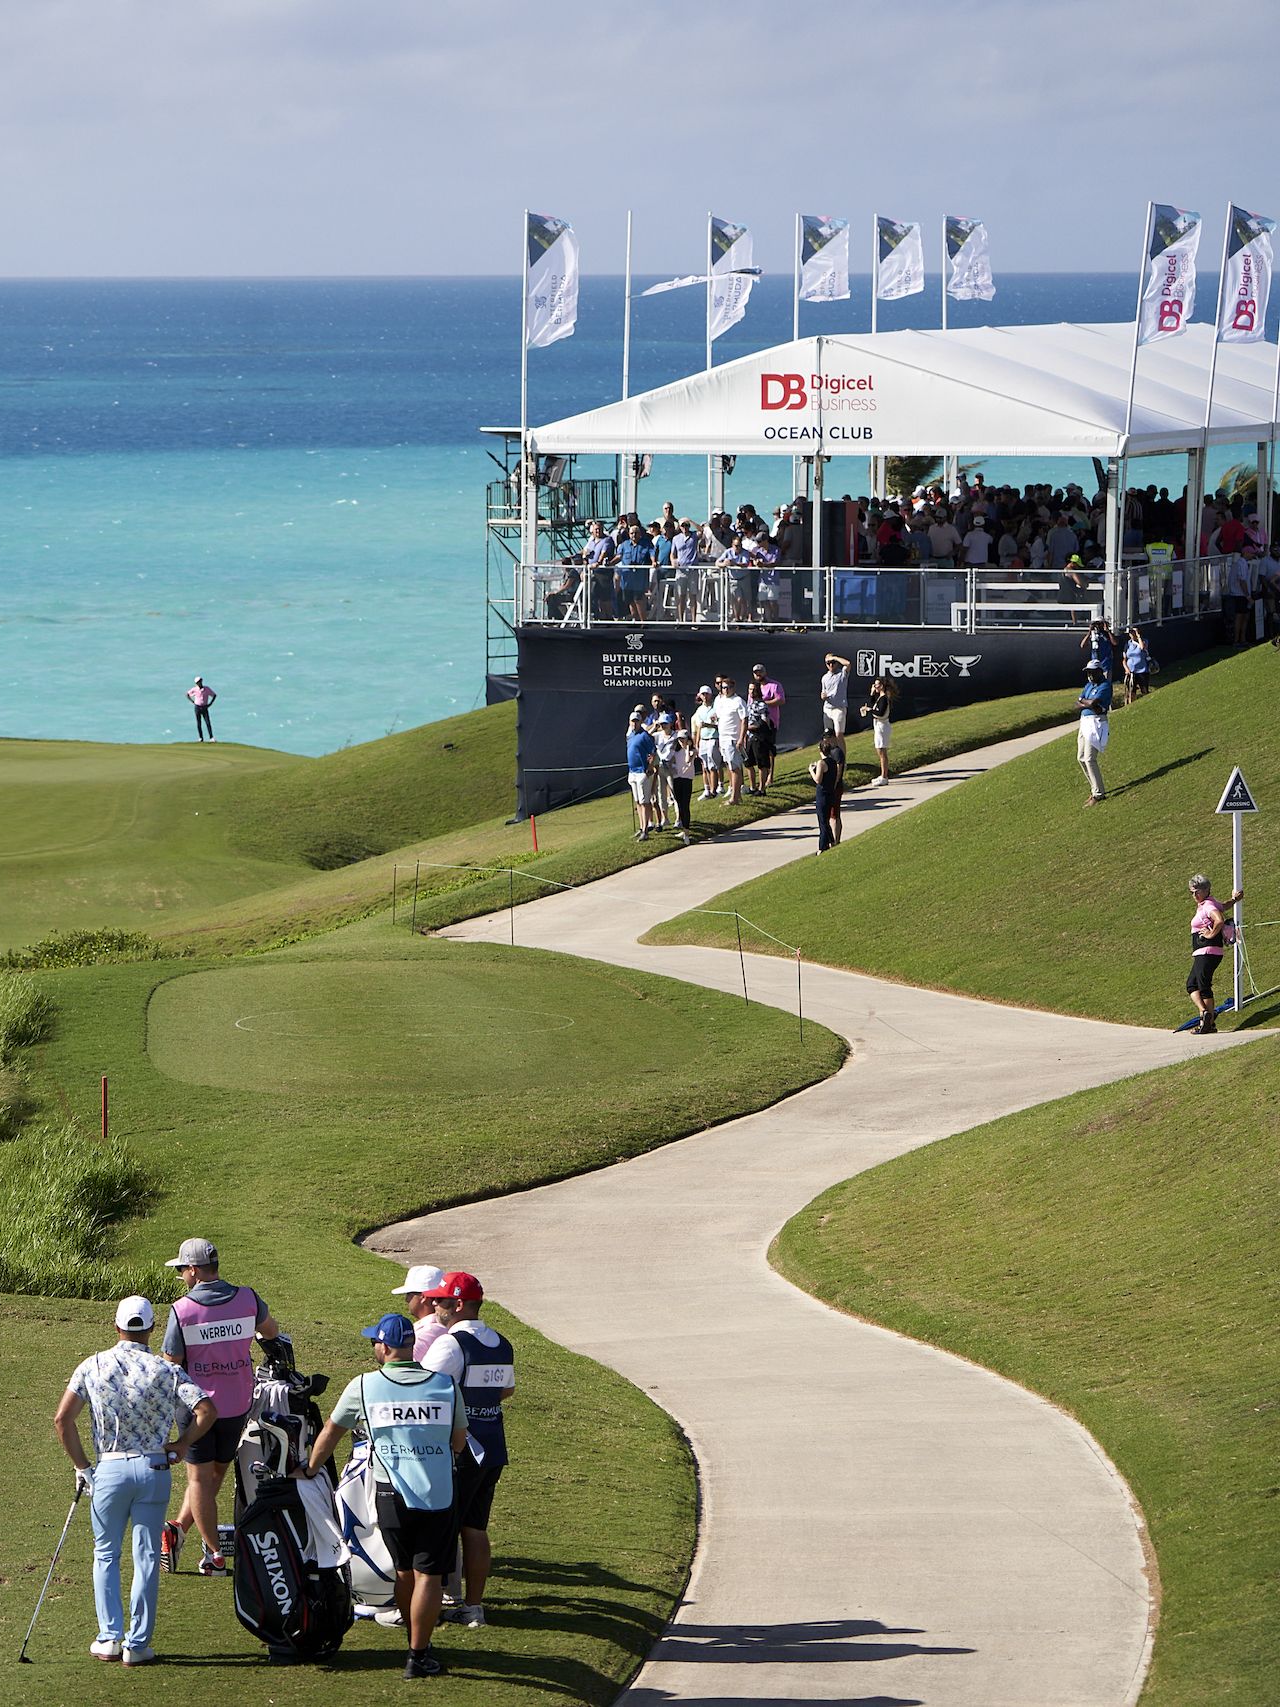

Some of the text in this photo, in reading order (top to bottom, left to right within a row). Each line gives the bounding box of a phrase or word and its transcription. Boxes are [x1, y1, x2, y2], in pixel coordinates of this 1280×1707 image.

[1161, 254, 1177, 297] Digicel
[1238, 254, 1253, 297] Digicel
[1158, 299, 1183, 332] DB
[1232, 299, 1256, 332] DB
[761, 374, 808, 410] DB
[811, 374, 874, 394] Digicel
[811, 394, 877, 411] Business
[764, 427, 873, 439] OCEAN CLUB
[602, 654, 671, 663] BUTTERFIELD
[879, 655, 949, 678] FedEx
[602, 666, 672, 677] BERMUDA
[603, 679, 673, 687] CHAMPIONSHIP
[200, 1323, 242, 1340] WERBYLO
[194, 1359, 251, 1373] BERMUDA
[380, 1444, 444, 1455] BERMUDA
[254, 1531, 293, 1615] SRIXON
